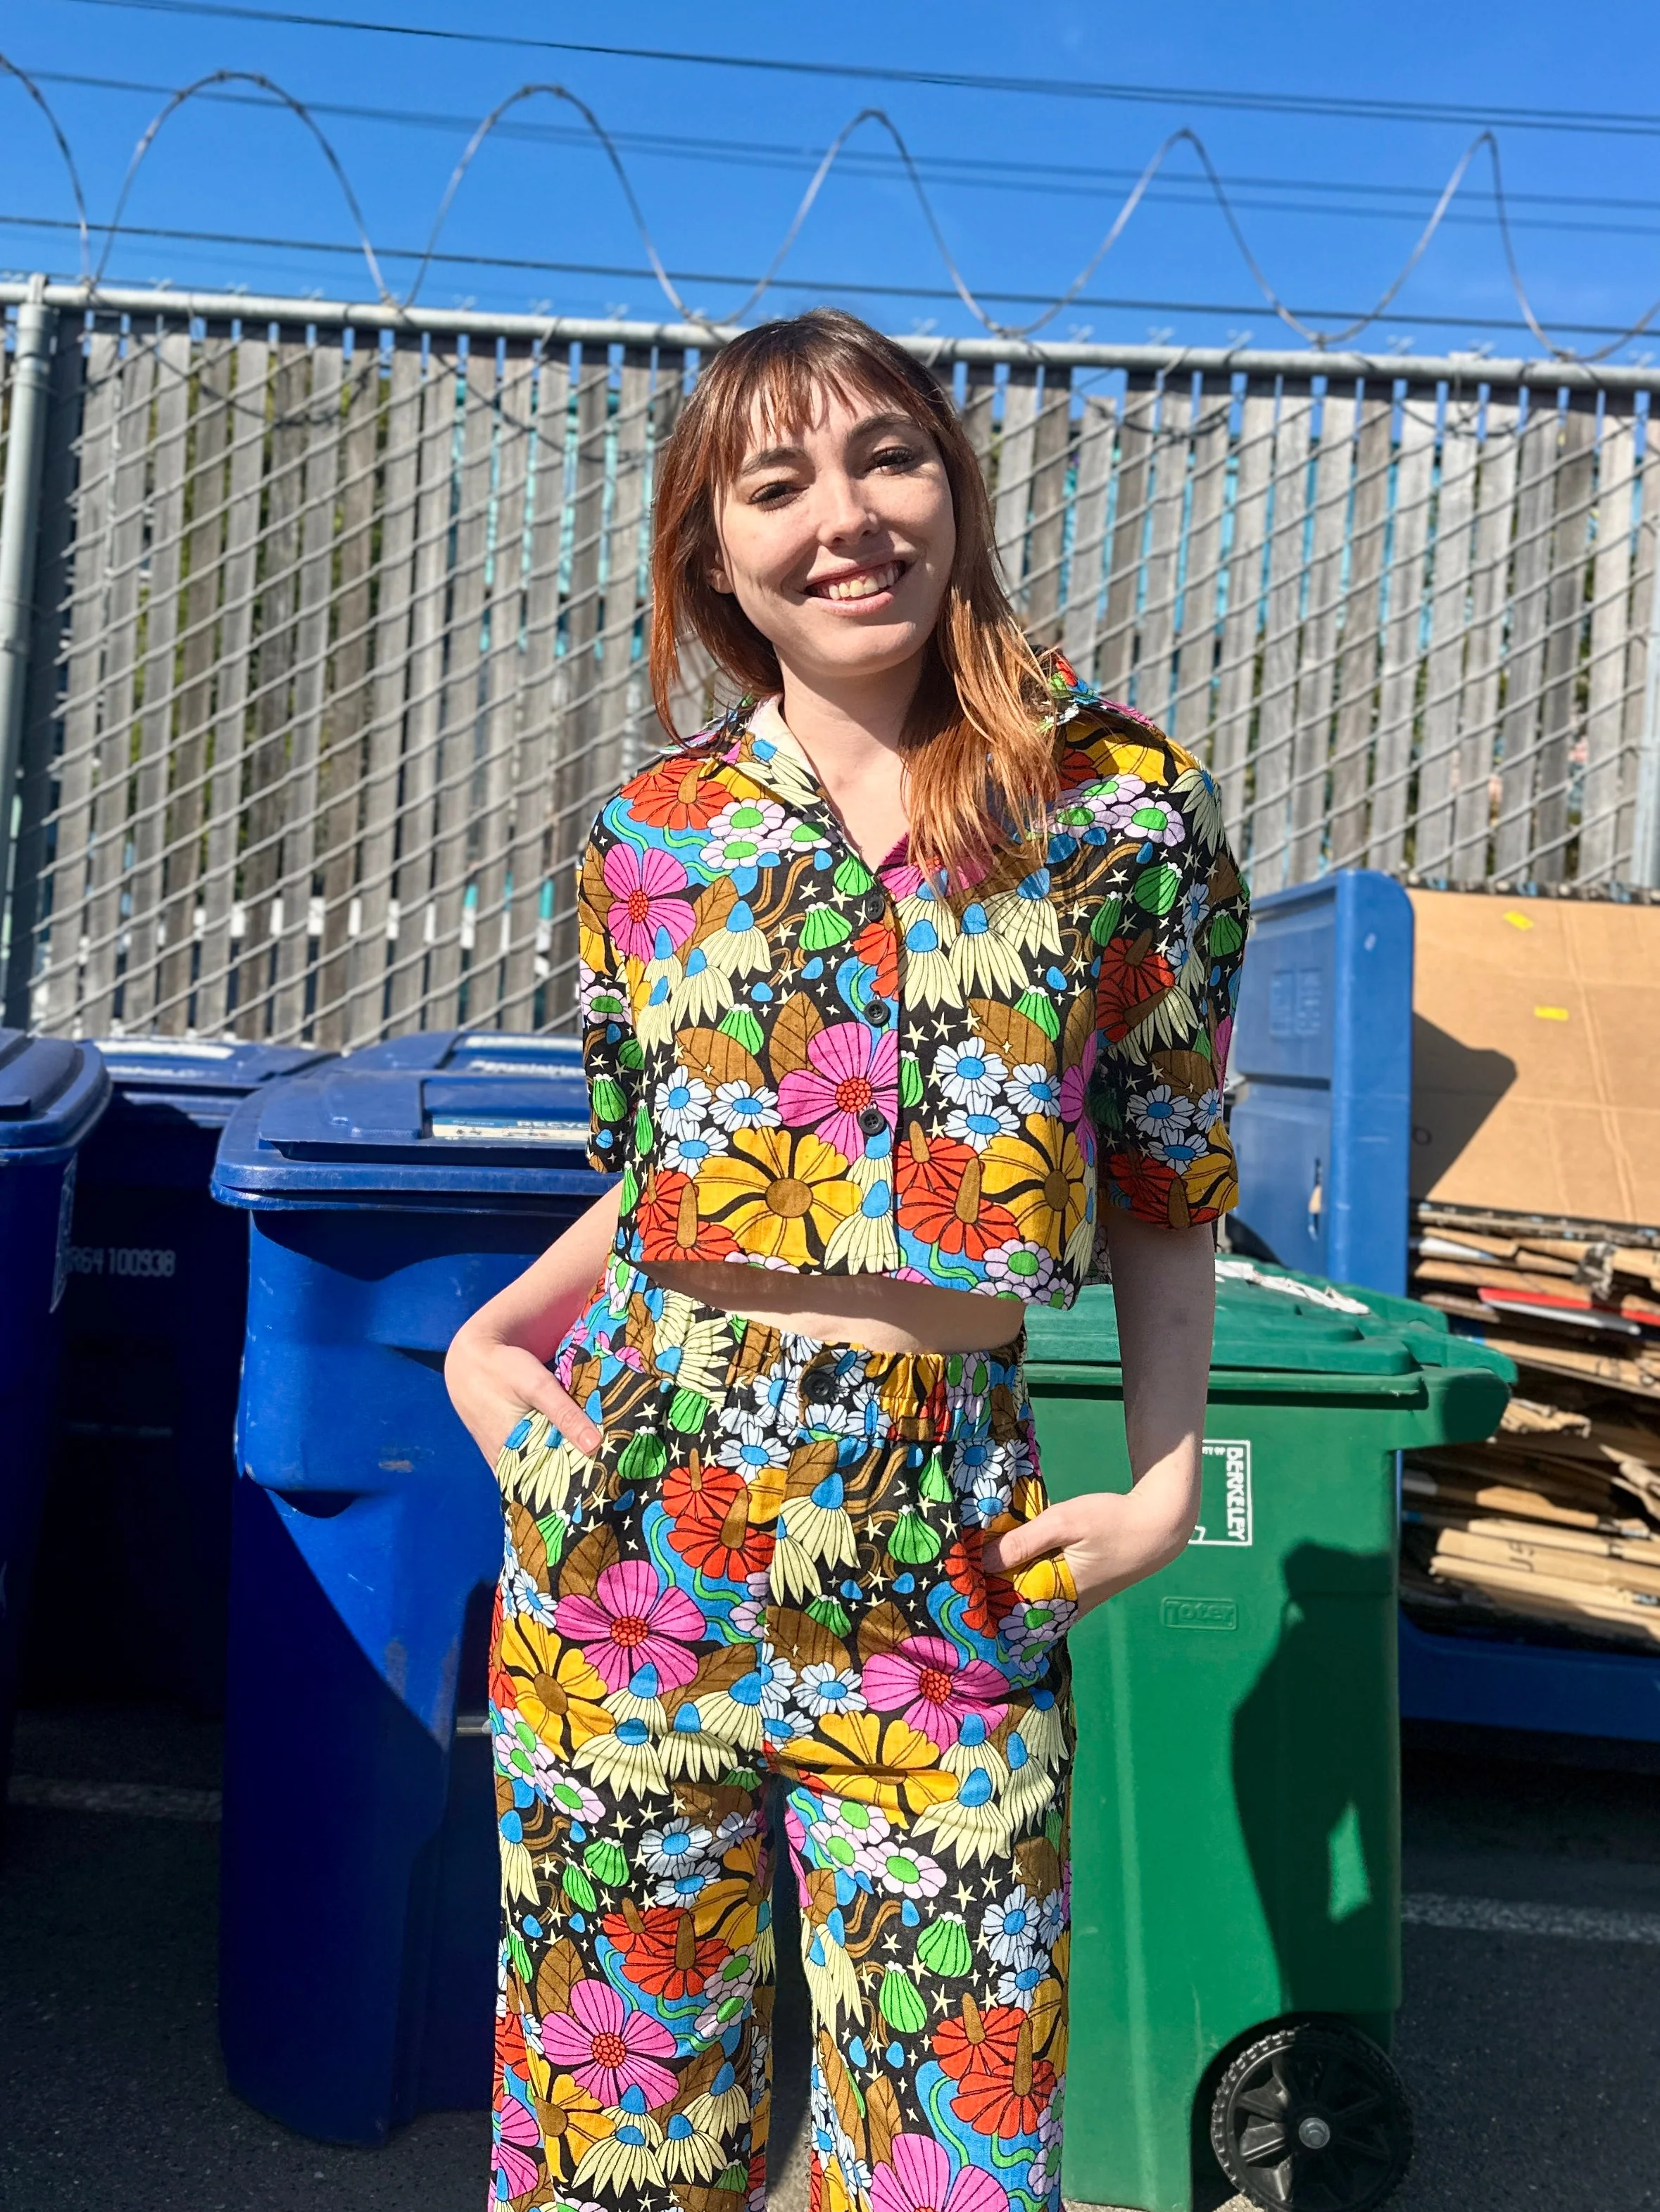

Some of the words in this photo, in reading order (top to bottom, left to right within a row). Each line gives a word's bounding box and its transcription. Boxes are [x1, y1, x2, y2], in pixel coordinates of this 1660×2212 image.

[517, 1120, 590, 1130] RECYC
[108, 1247, 176, 1278] 100938
[1226, 1447, 1245, 1541] BERKELEY
